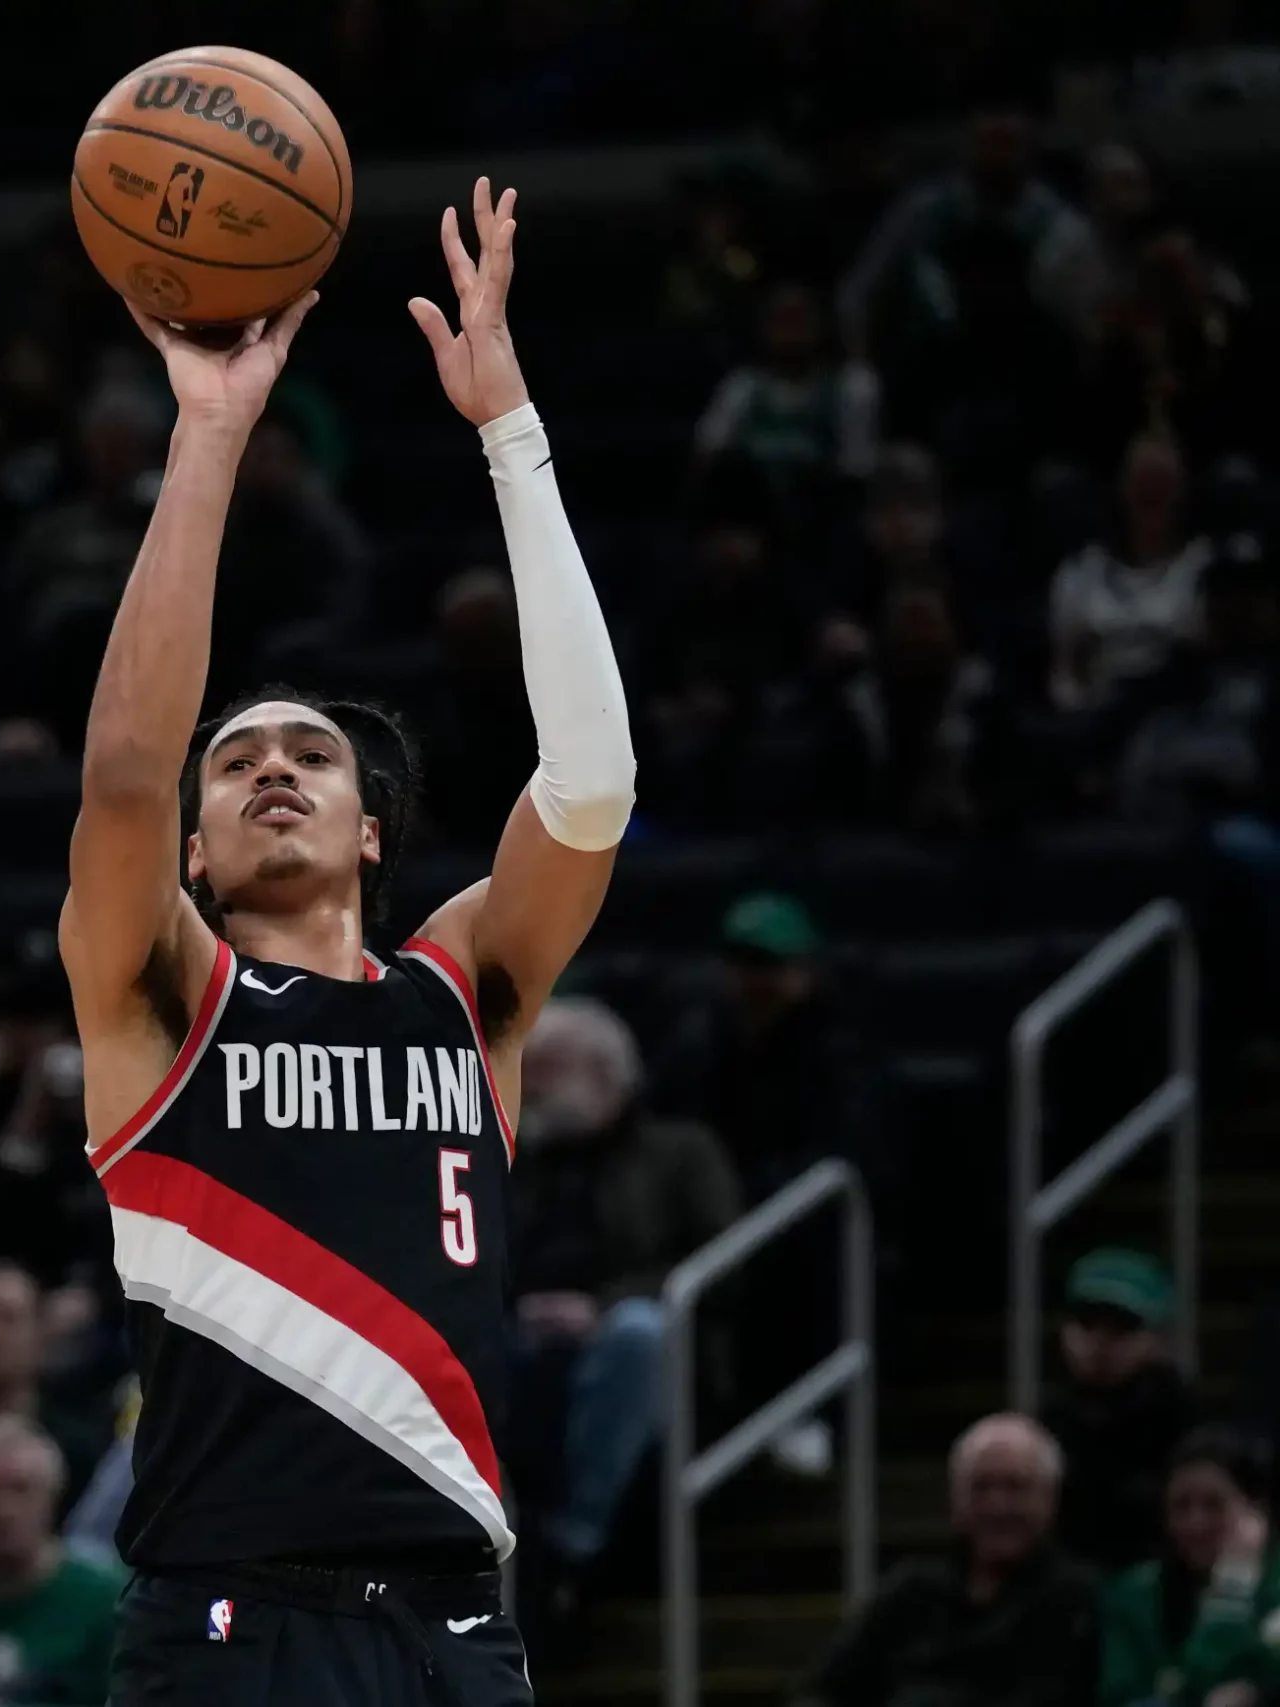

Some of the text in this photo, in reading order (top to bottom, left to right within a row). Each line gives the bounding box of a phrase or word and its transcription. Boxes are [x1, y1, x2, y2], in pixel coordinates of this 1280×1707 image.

[134, 76, 303, 174] Wilson
[217, 1042, 482, 1136] PORTLAND
[438, 1147, 478, 1267] 5
